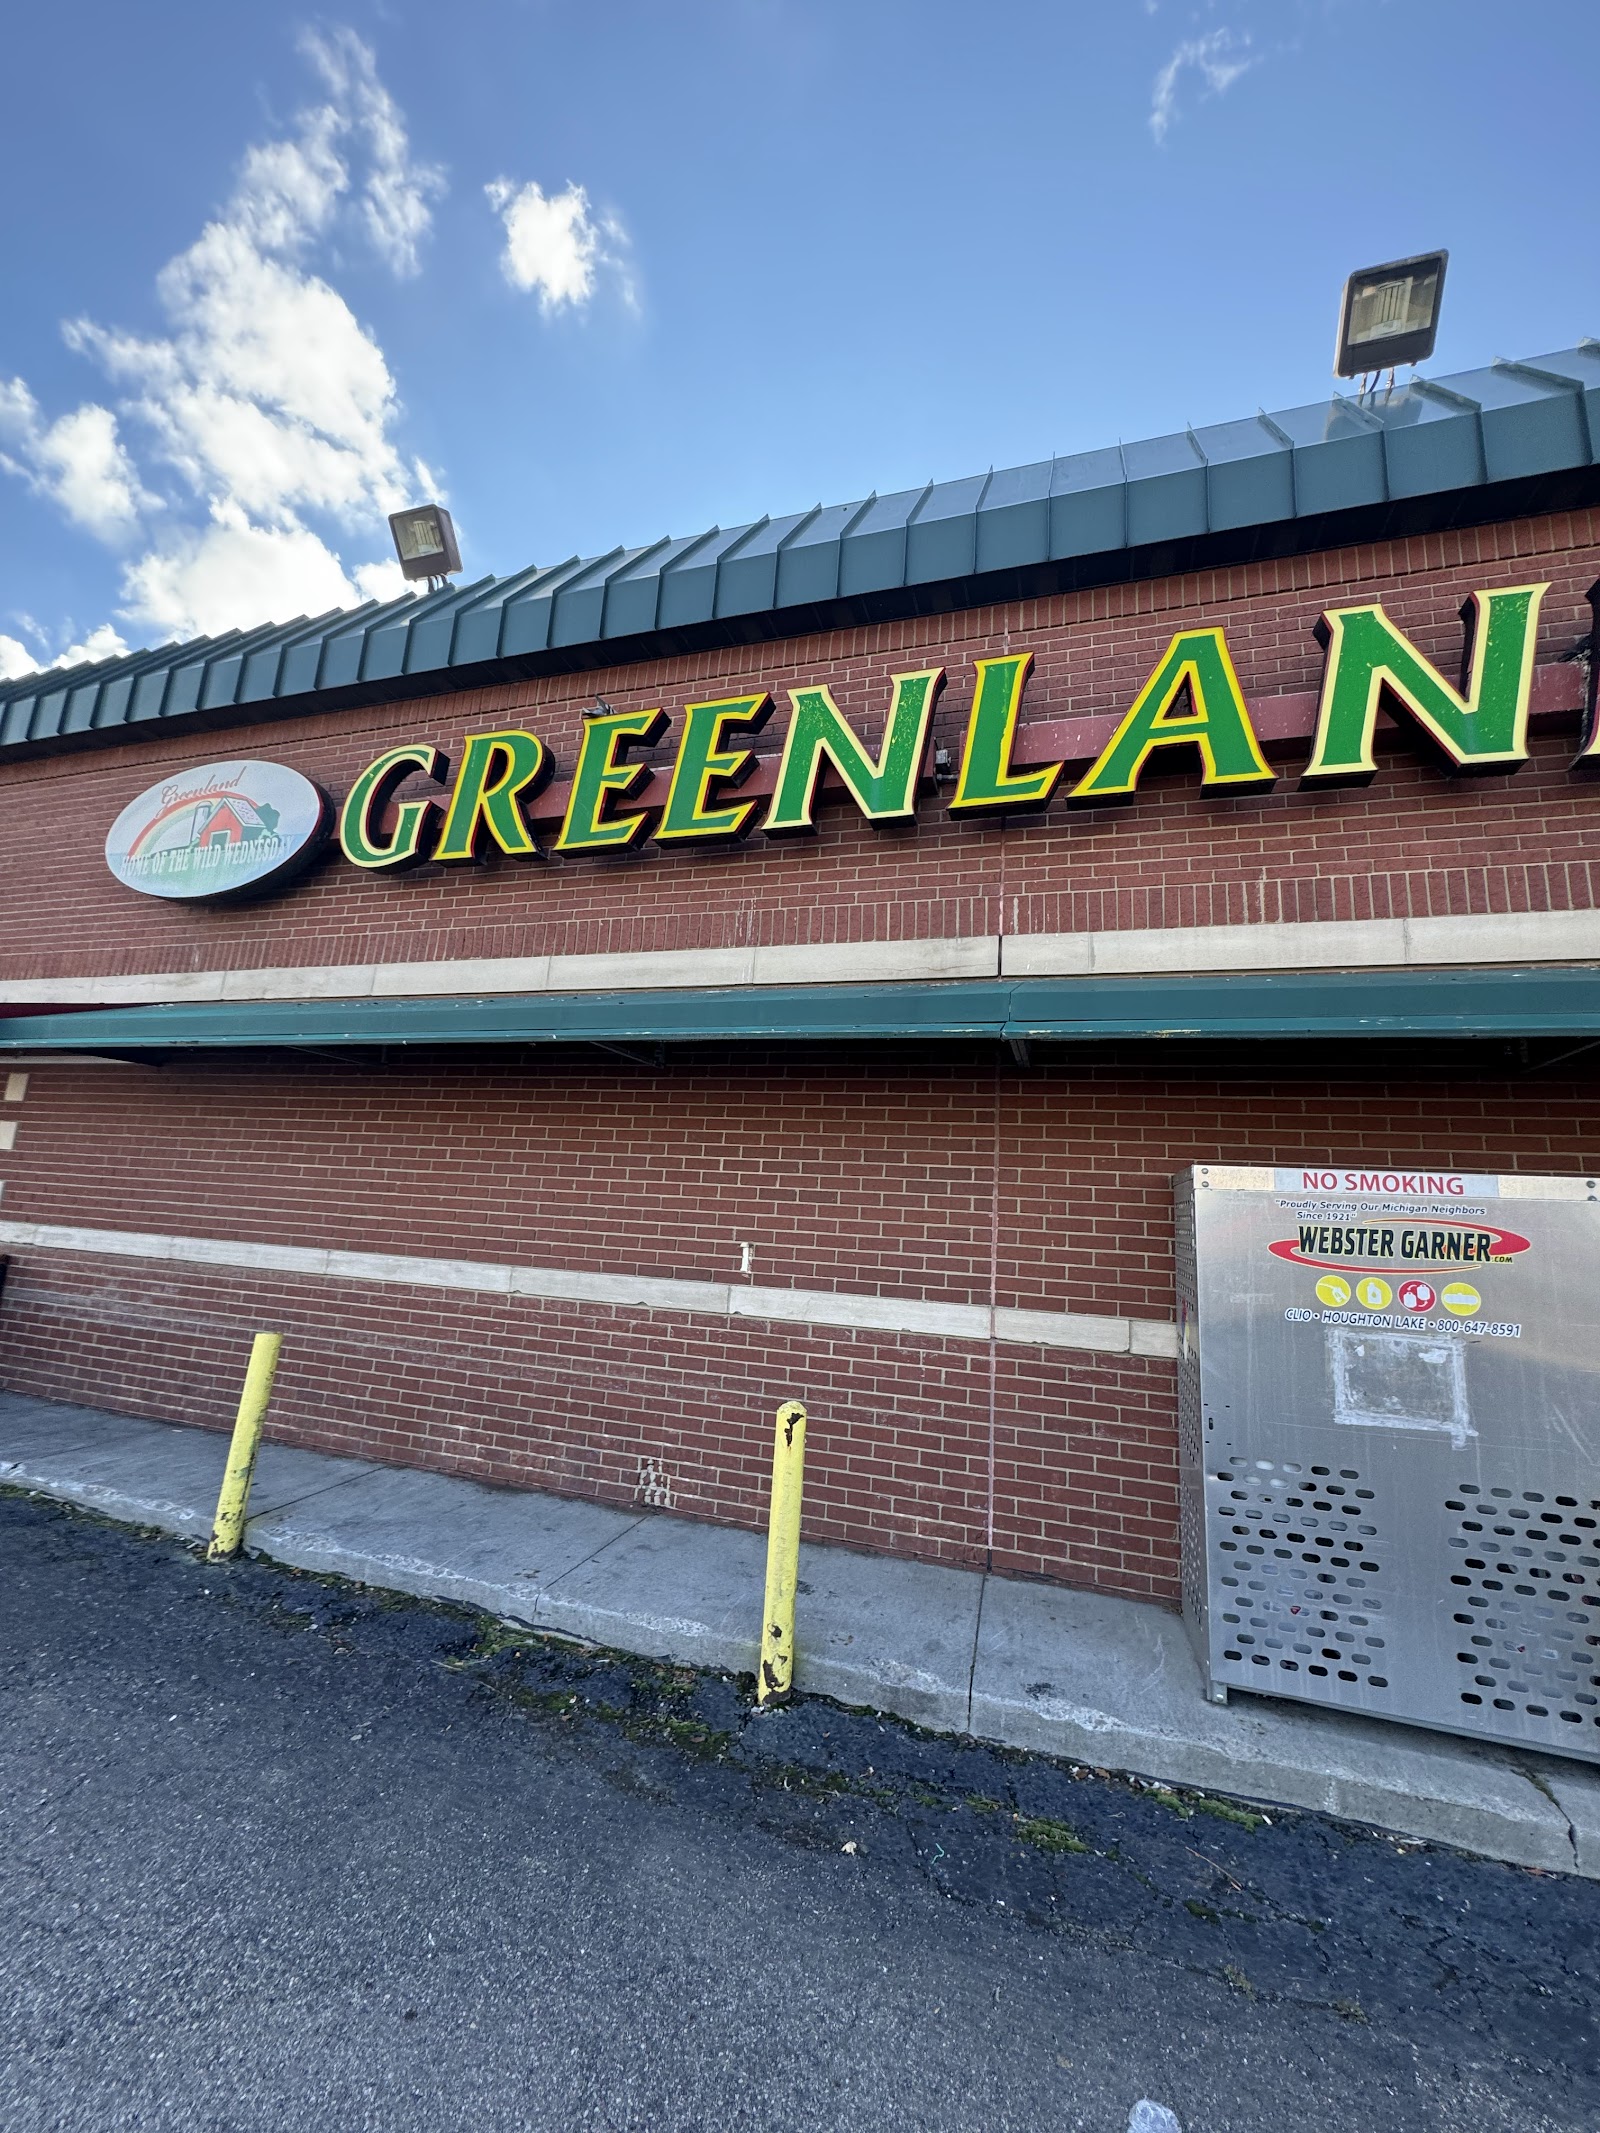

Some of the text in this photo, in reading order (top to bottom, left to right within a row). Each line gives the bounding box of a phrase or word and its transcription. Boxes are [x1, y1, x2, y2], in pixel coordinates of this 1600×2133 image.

[340, 576, 1600, 870] GREENLAN
[155, 766, 248, 820] Greenland
[119, 834, 295, 878] HOME OF THE WILD WEDNESDAY
[1302, 1172, 1465, 1196] NO SMOKING
[1275, 1199, 1487, 1216] "Proudly Serving Our Michigan Neighbors
[1296, 1211, 1357, 1222] Since 1921"
[1297, 1225, 1395, 1258] WEBSTER
[1400, 1229, 1492, 1263] GARNER
[1285, 1308, 1521, 1338] CLIO HOUGHTON LAKE 800-647-8591
